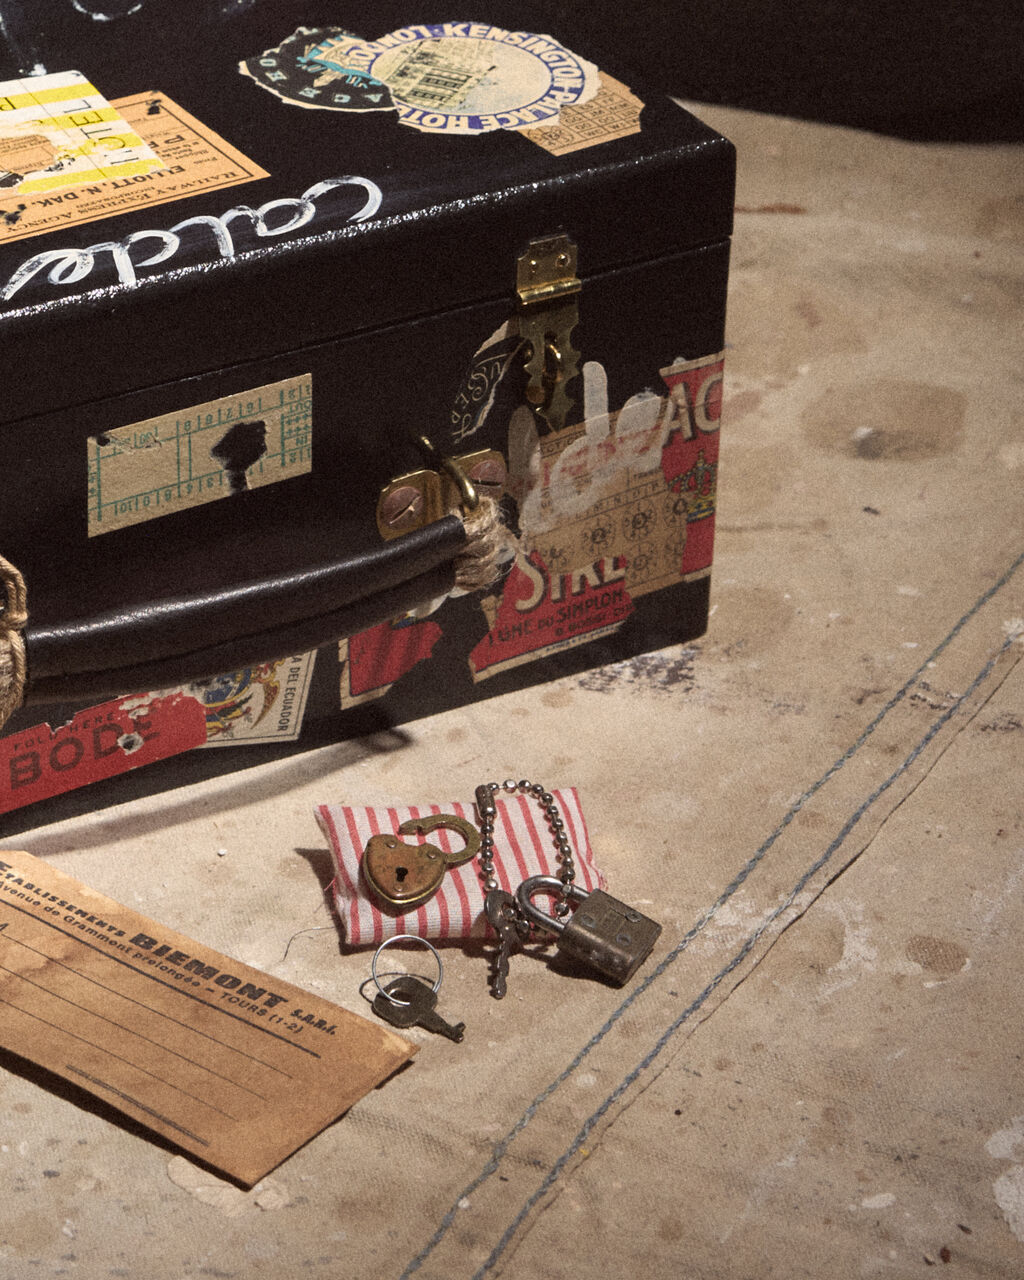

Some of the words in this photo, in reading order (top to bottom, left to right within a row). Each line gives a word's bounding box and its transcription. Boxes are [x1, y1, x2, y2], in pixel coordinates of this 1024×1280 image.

[100, 164, 186, 190] ELLIOTT,
[154, 171, 238, 195] RAILWAY
[29, 191, 79, 208] DAK.
[79, 186, 103, 196] N.
[76, 193, 150, 215] EXPRESS
[3, 211, 75, 233] AGENCY
[286, 666, 300, 683] DEL
[276, 683, 296, 732] ECUADOR
[126, 929, 293, 1012] BIEMONT
